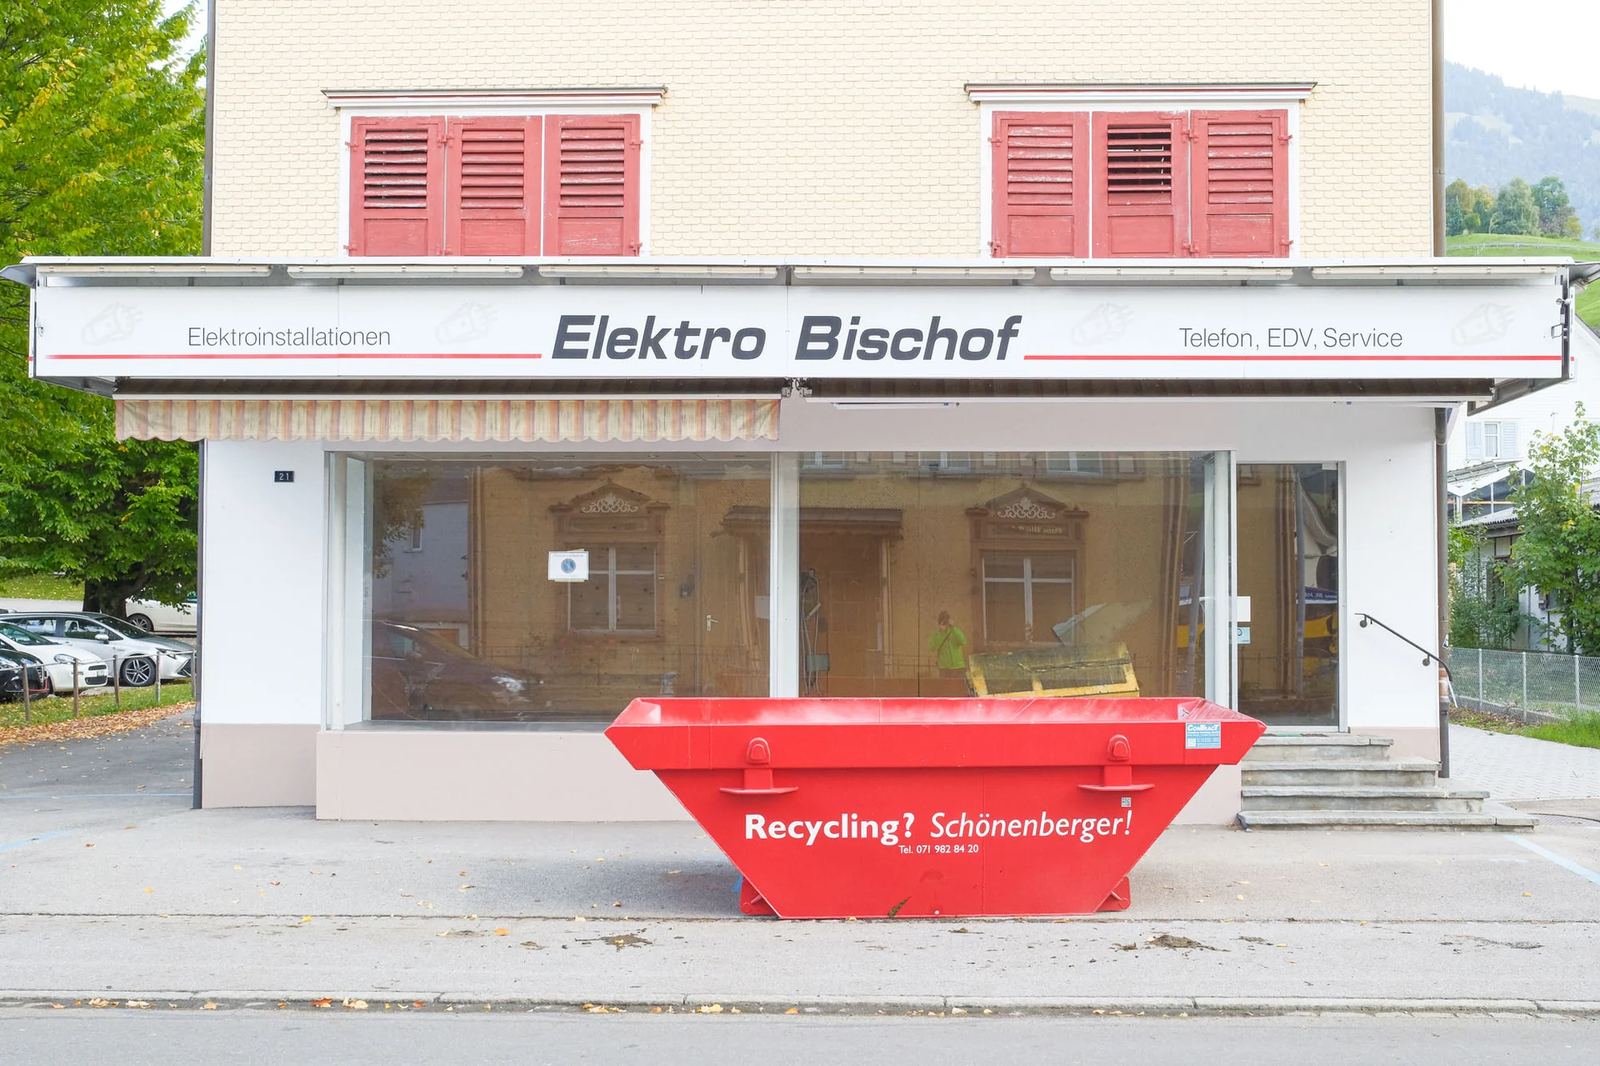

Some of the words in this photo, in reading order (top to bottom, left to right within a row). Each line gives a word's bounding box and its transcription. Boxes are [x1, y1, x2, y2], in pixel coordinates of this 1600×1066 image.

[188, 327, 391, 348] Elektroinstallationen
[552, 314, 766, 360] Elektro
[795, 315, 1022, 361] Bischof
[1180, 328, 1260, 350] Telefon,
[1268, 328, 1318, 350] EDV,
[1323, 327, 1404, 348] Service
[279, 472, 289, 481] 21
[744, 812, 915, 846] Recycling?
[930, 810, 1134, 844] Schönenberger!
[898, 844, 914, 855] Tel.
[916, 844, 931, 854] 071
[934, 844, 951, 854] 982
[953, 844, 966, 854] 84
[967, 843, 980, 854] 20
